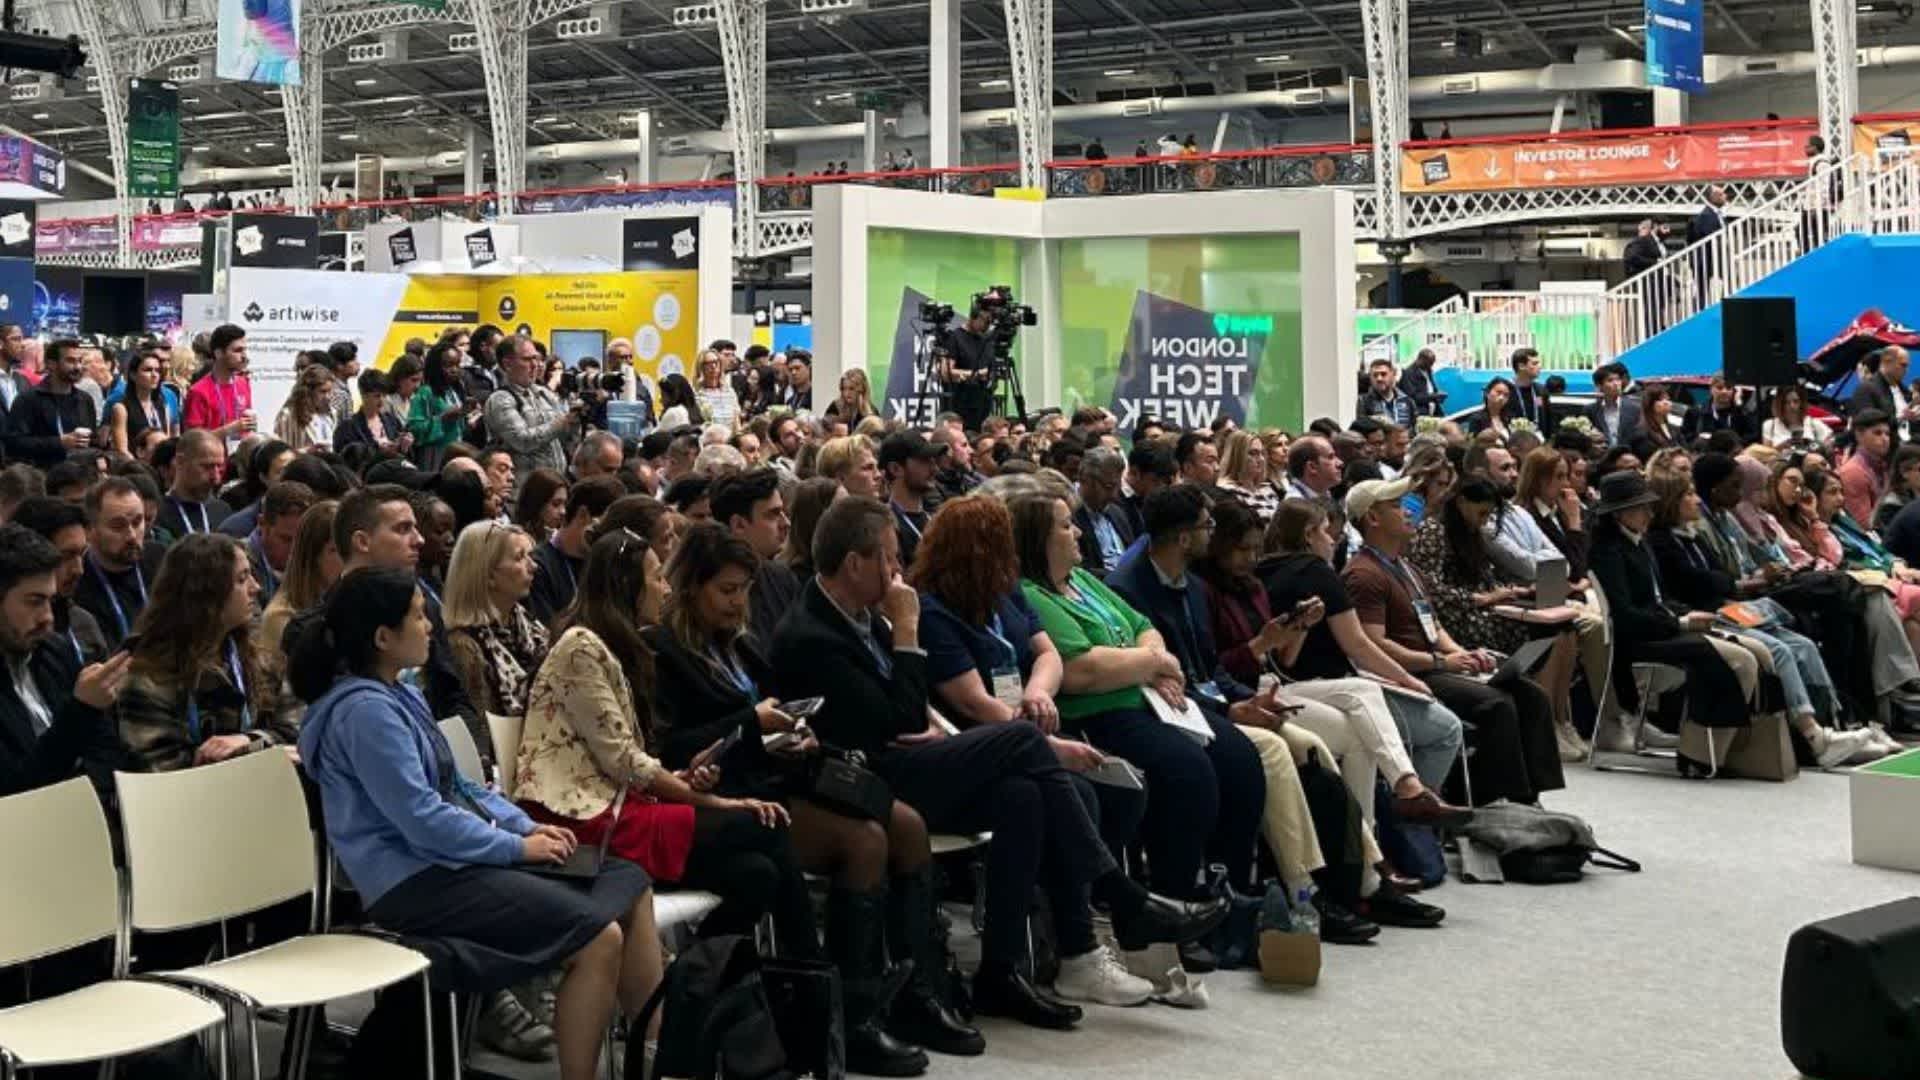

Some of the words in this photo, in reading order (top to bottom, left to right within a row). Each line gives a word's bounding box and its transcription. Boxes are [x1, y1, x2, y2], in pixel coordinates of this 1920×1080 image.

[1514, 149, 1585, 163] INVESTOR
[1589, 145, 1650, 160] LOUNGE
[269, 305, 339, 321] artiwise
